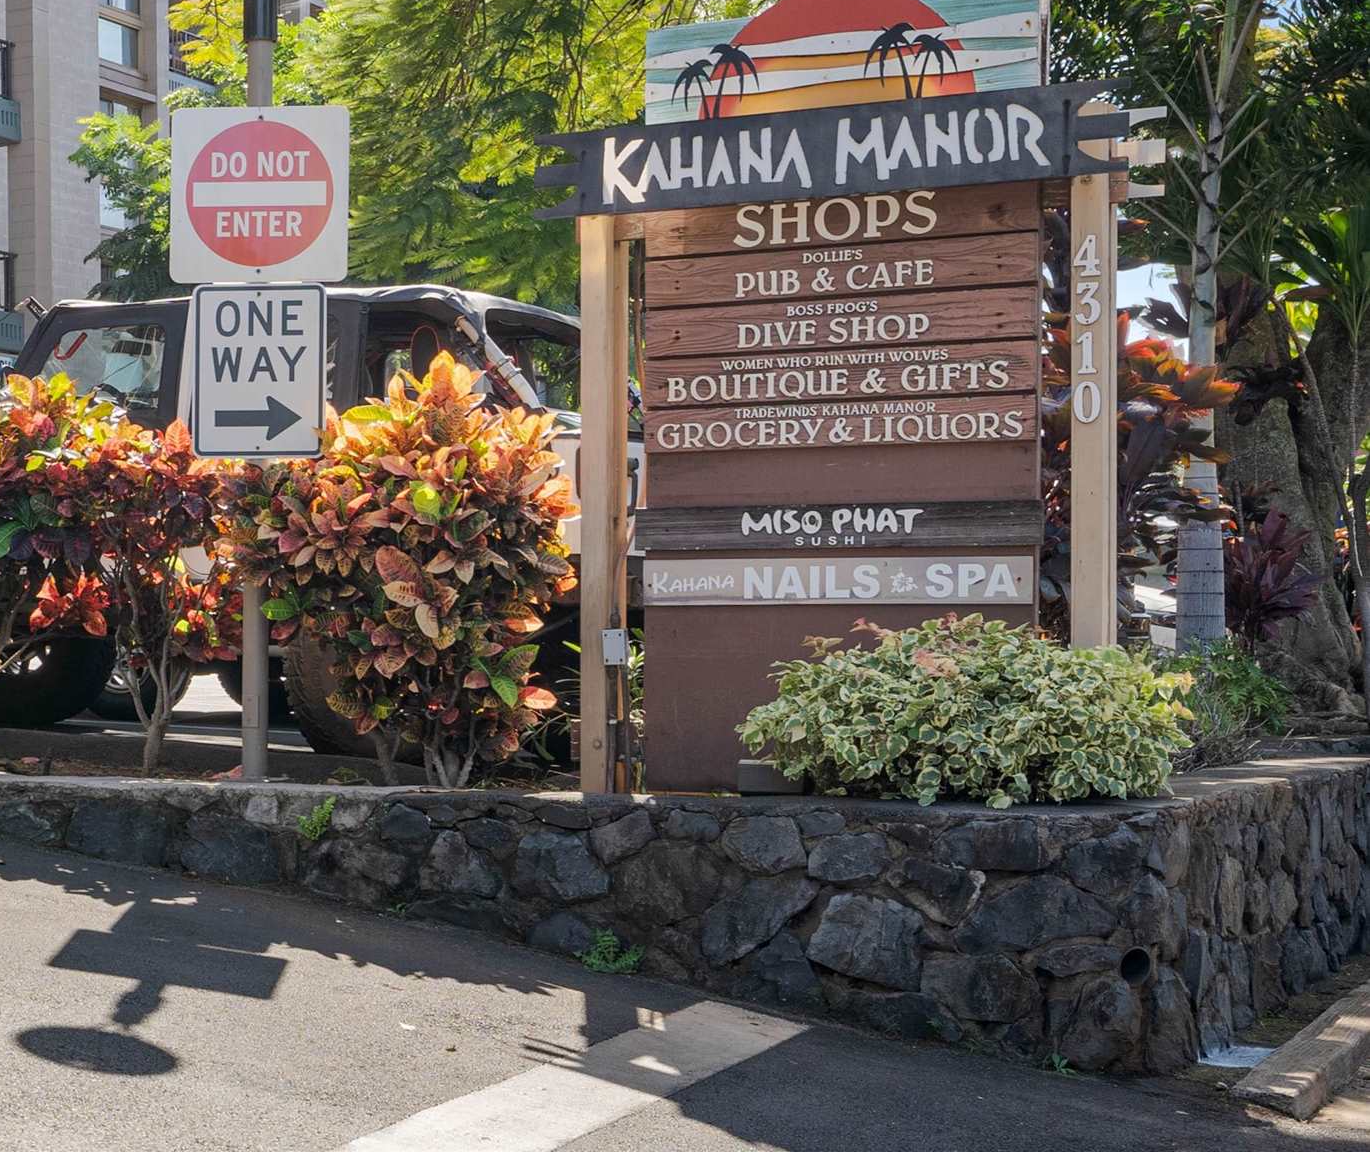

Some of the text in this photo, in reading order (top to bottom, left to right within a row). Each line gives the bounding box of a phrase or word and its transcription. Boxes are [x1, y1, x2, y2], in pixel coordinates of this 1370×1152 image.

[210, 150, 311, 178] DO NOT
[603, 103, 1051, 205] KAHANA MANOR
[215, 210, 303, 239] ENTER
[733, 190, 938, 249] SHOPS
[802, 249, 863, 264] DOLLIE'S
[734, 259, 935, 298] PUB & CAFE
[215, 300, 304, 337] ONE
[786, 300, 879, 317] BOSS FROG'S
[737, 313, 930, 349] DIVE SHOP
[1073, 234, 1102, 424] 4310
[212, 346, 306, 382] WAY
[721, 348, 949, 370] WOMEN WHO RUN WITH WOLVES
[666, 360, 1010, 403] BOUTIQUE & GIFTS
[734, 401, 936, 419] TRADEWINDS KAHANA MANOR
[657, 410, 1023, 449] GROCERY & LIQUORS
[741, 508, 924, 535] MISO PHAT
[795, 535, 866, 546] SUSHI
[652, 563, 1018, 599] KAHANA NAILS SPA
